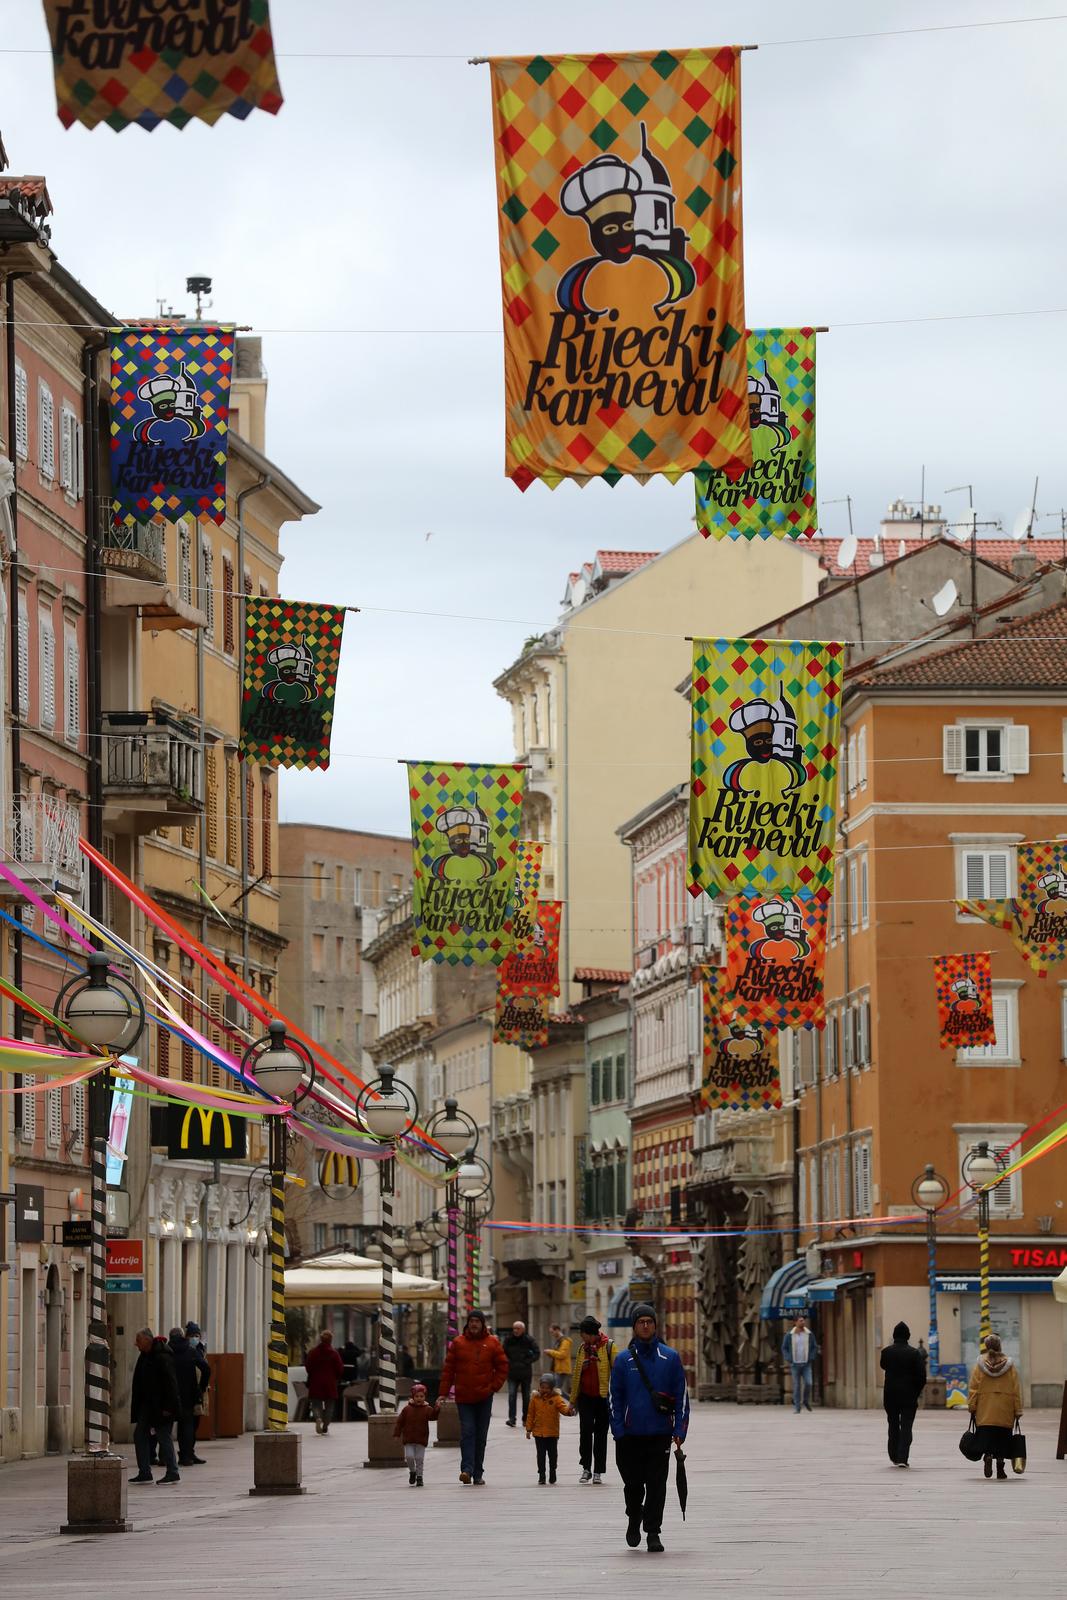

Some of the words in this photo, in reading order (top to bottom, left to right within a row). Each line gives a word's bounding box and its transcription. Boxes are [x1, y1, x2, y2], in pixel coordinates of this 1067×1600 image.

[55, 0, 255, 70] karneval
[523, 351, 724, 427] karneval
[704, 472, 806, 508] karneval
[697, 817, 824, 859] karneval
[420, 898, 508, 933] karneval
[1026, 925, 1067, 944] karne
[732, 974, 820, 1002] karneval
[707, 1064, 774, 1089] karneval
[109, 1256, 140, 1266] Lutrija
[941, 1283, 969, 1291] TISAK
